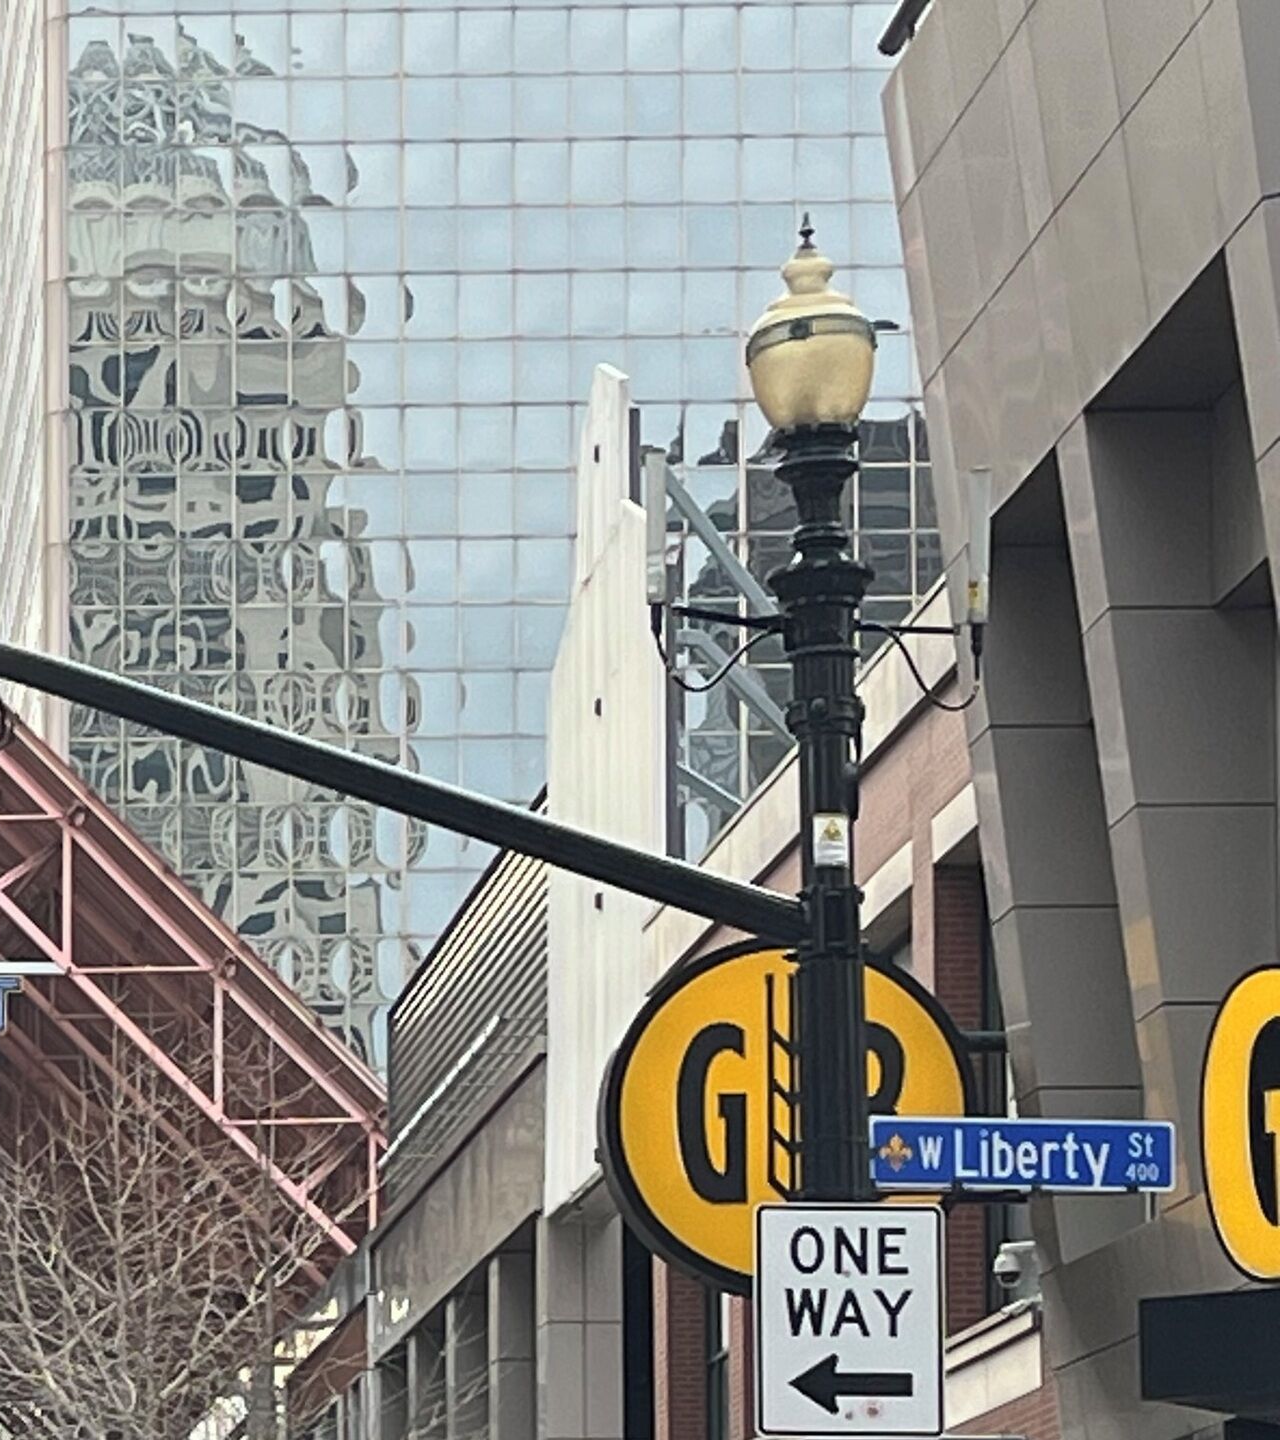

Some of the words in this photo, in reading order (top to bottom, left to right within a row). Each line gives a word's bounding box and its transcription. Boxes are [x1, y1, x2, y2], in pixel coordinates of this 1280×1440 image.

[918, 1135, 944, 1171] W
[954, 1128, 1110, 1189] Liberty
[1127, 1131, 1155, 1159] St
[1124, 1163, 1160, 1183] 400
[790, 1225, 910, 1275] ONE
[785, 1288, 914, 1338] WAY
